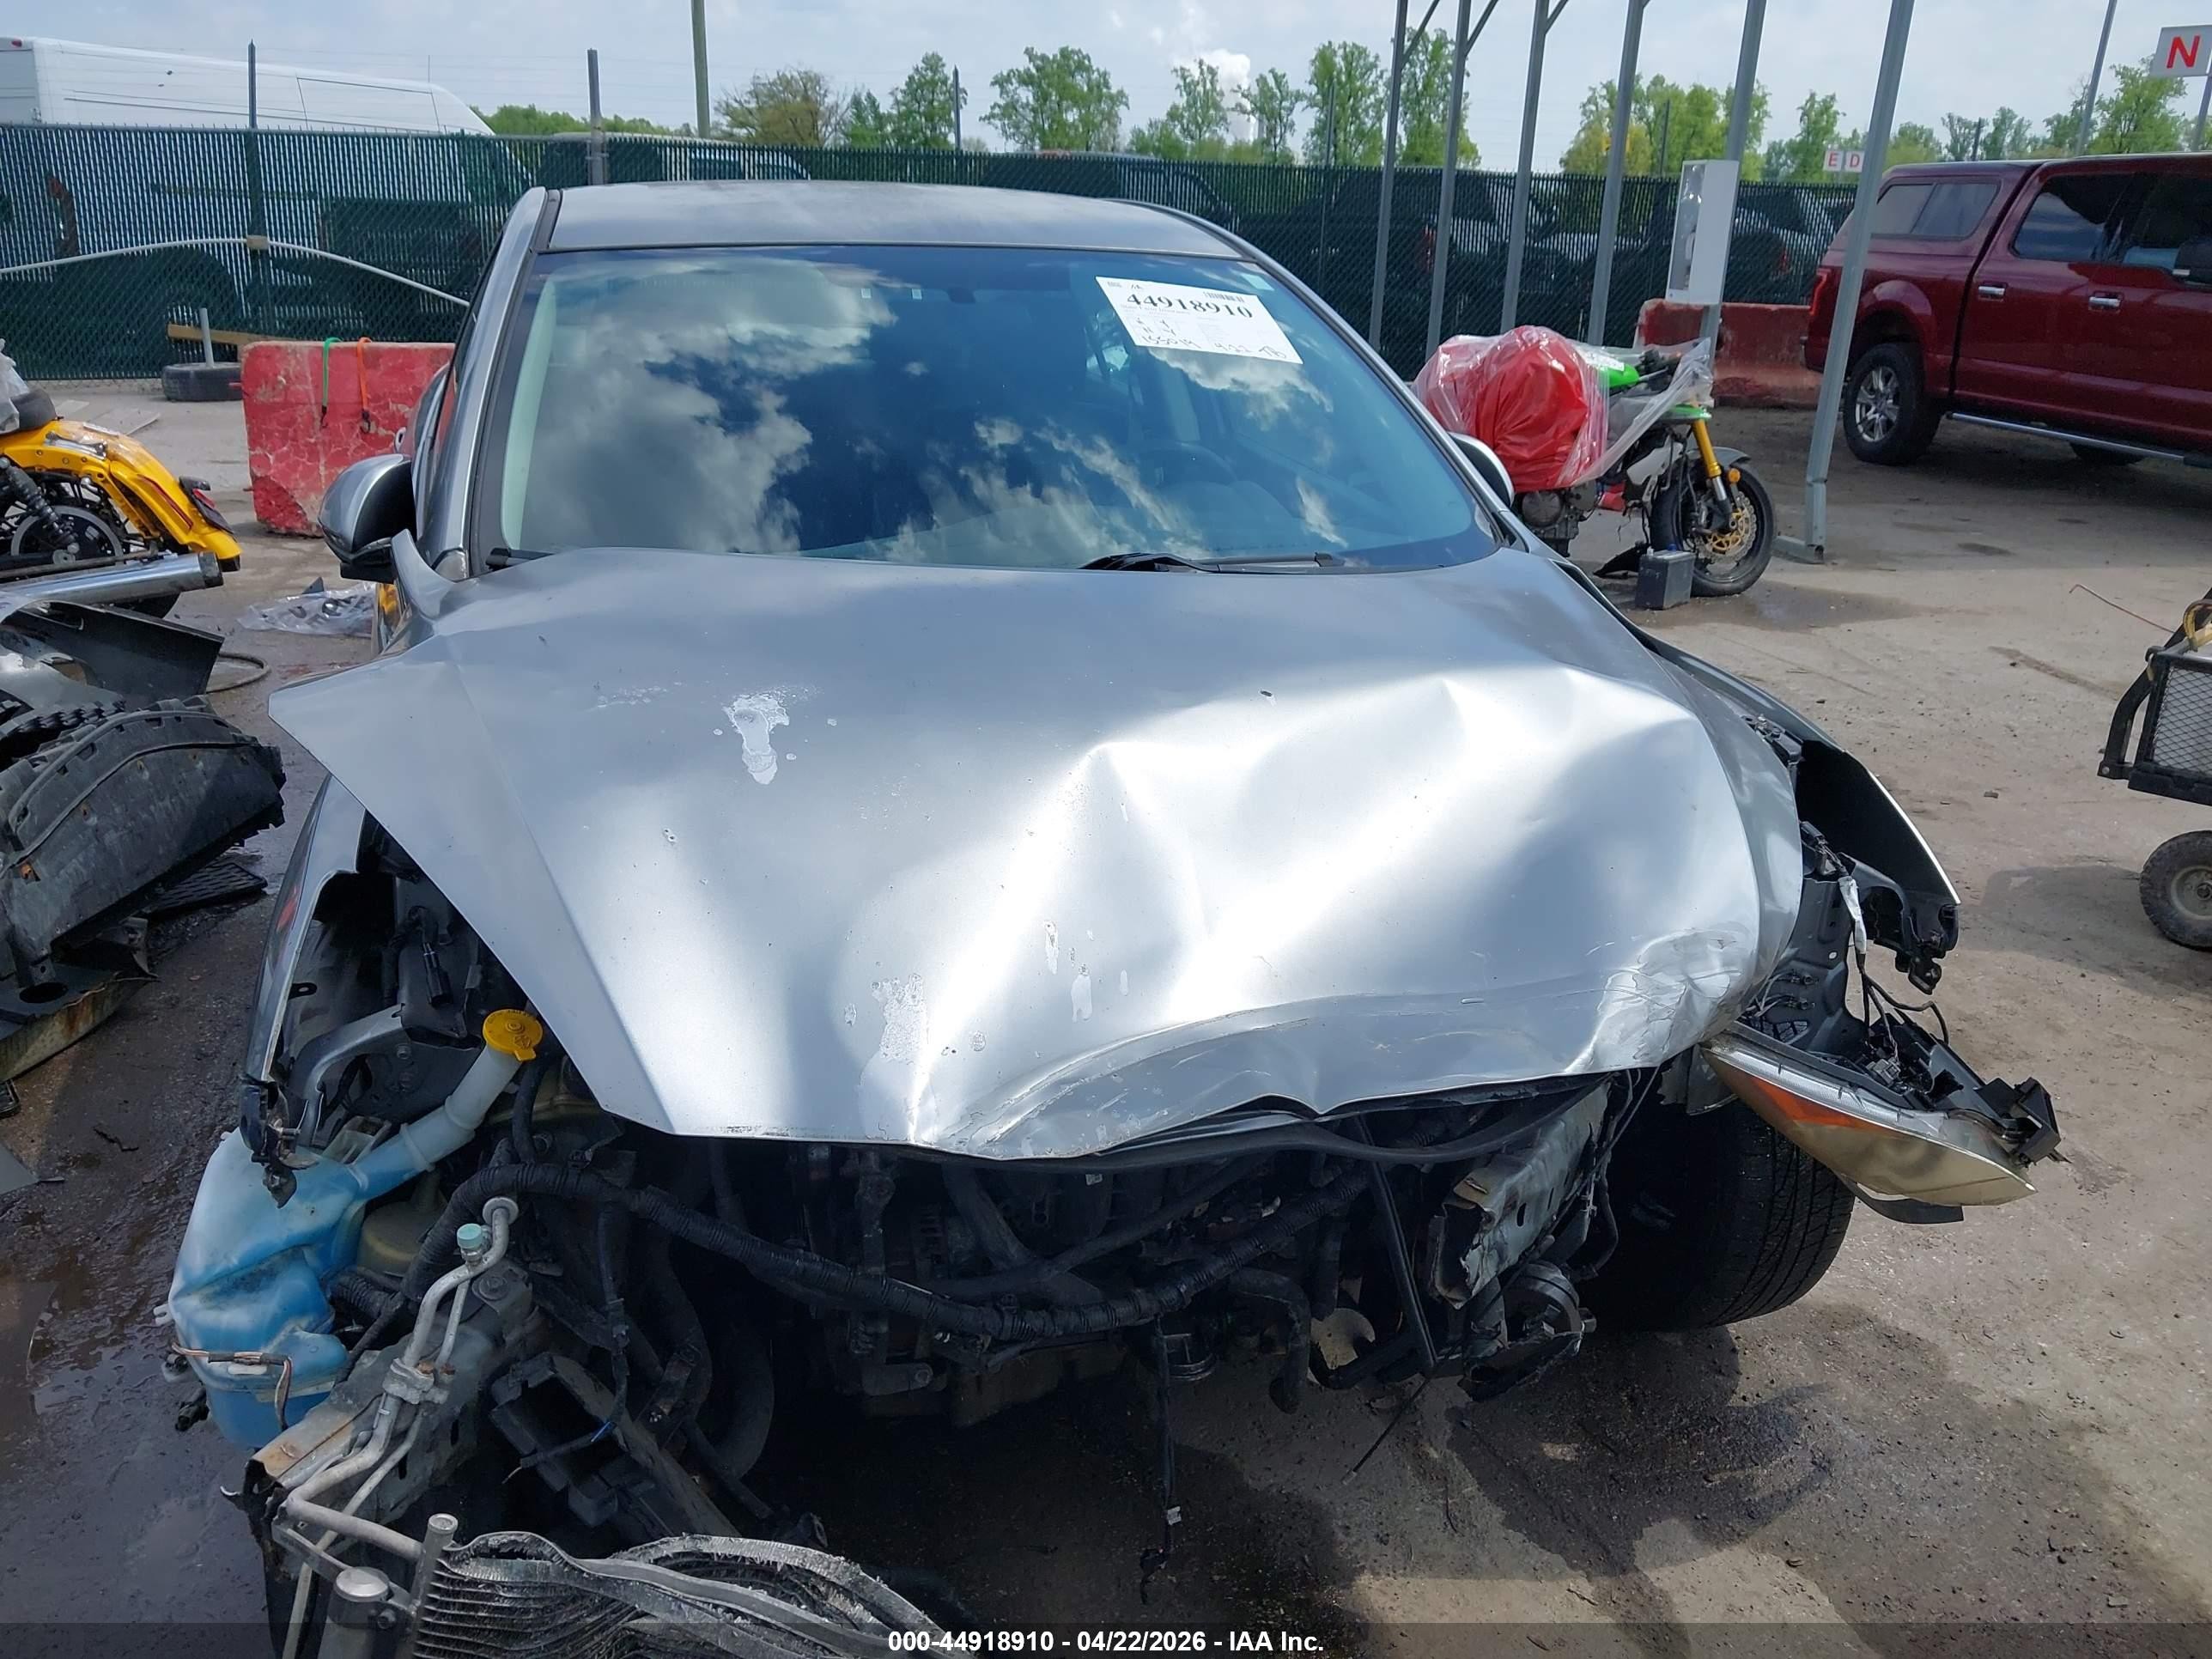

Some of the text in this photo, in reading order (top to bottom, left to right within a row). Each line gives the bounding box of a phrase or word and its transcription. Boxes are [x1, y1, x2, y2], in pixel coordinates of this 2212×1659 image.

[2166, 34, 2201, 69] N
[1828, 151, 1861, 168] E D
[1127, 294, 1253, 319] 44918910
